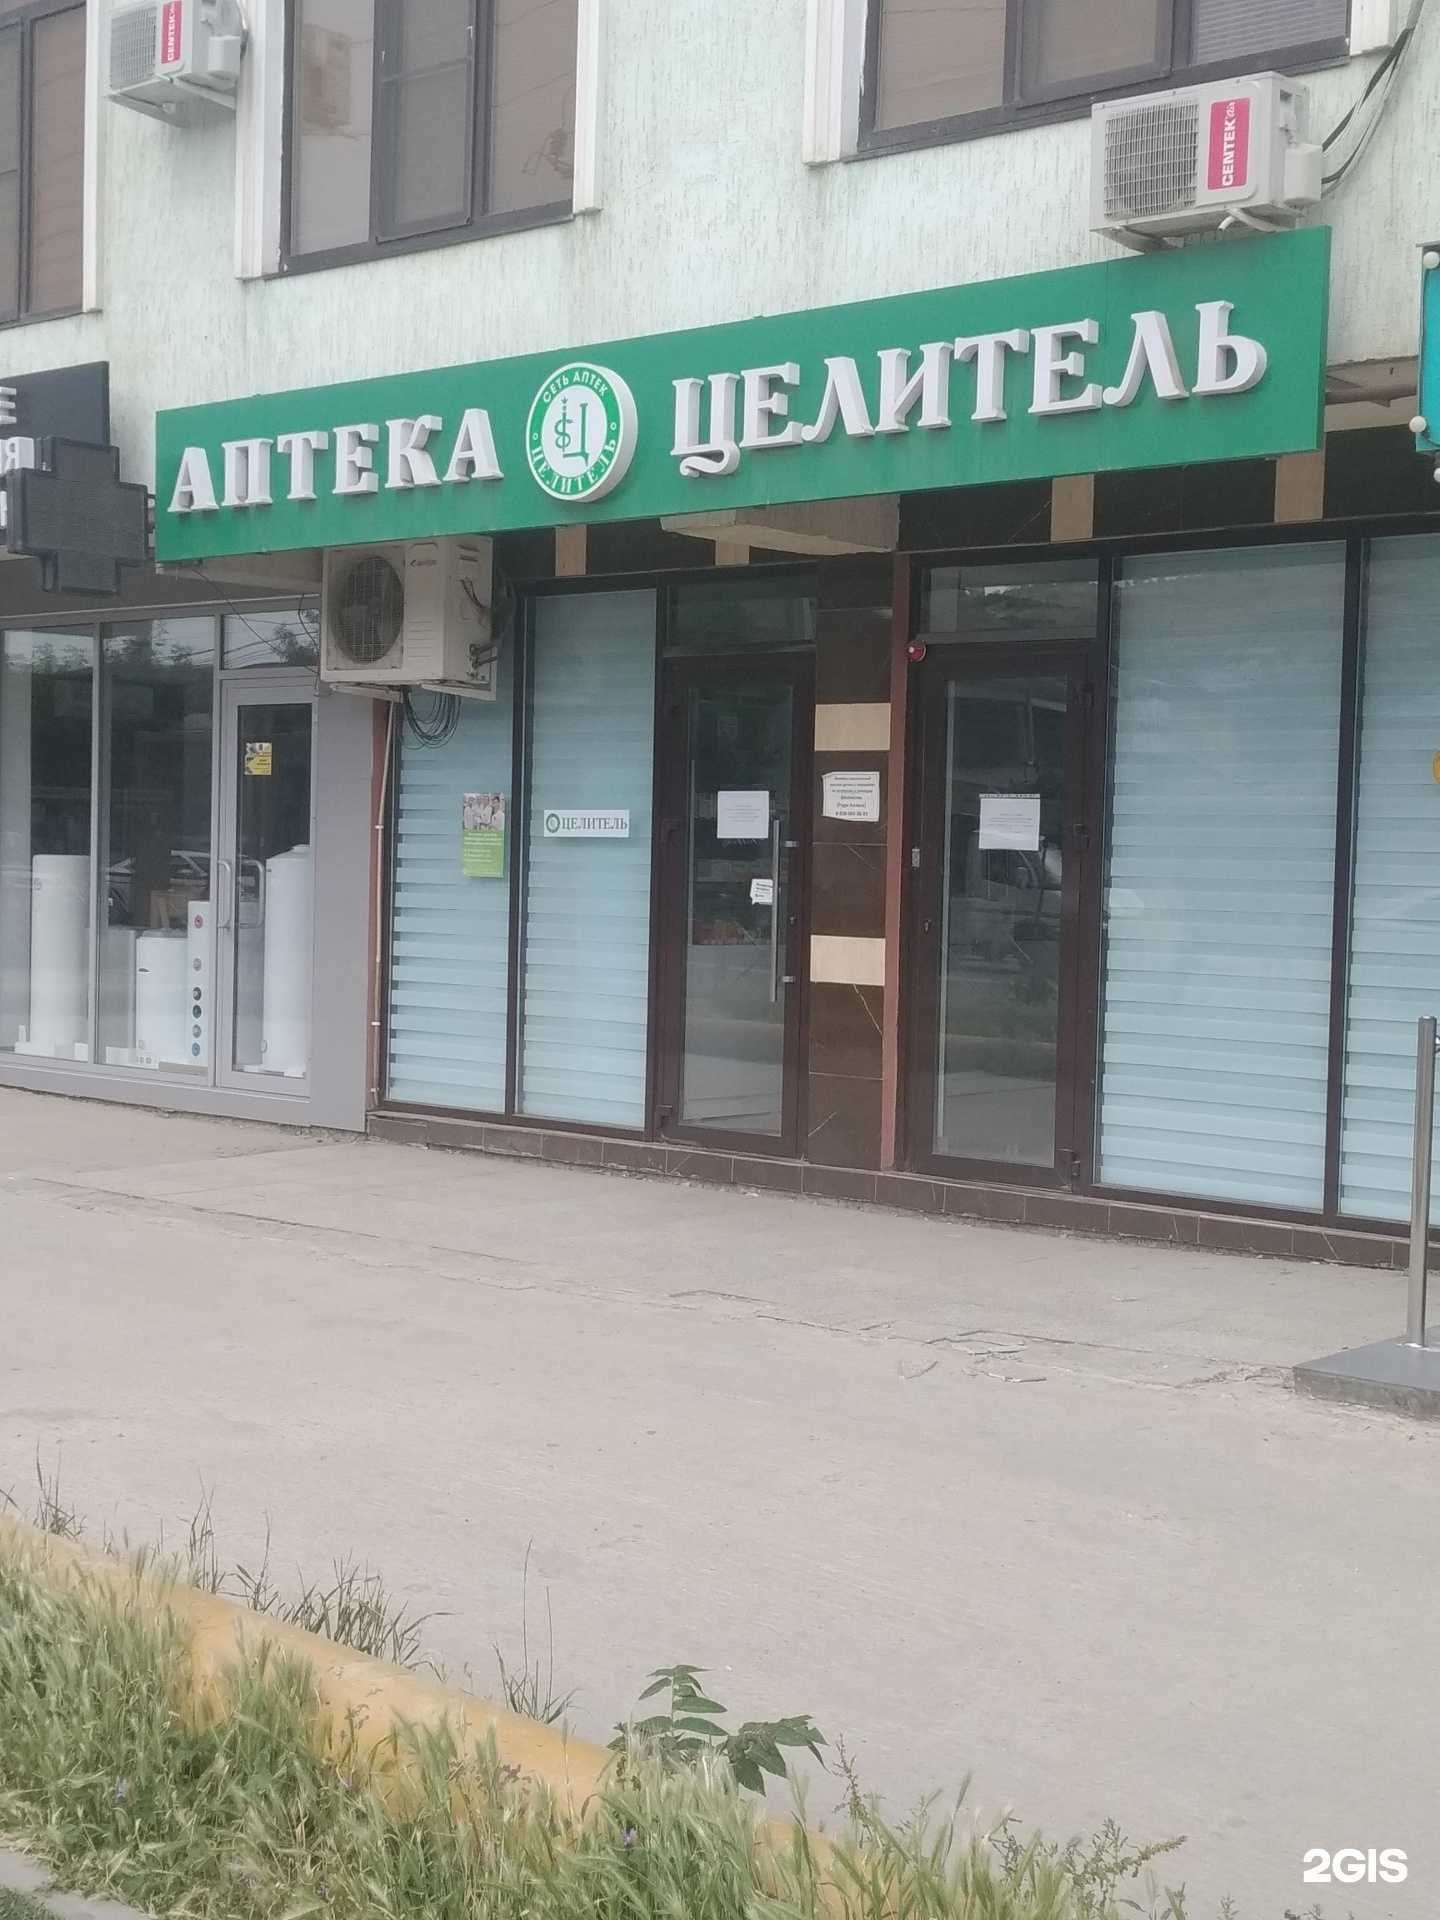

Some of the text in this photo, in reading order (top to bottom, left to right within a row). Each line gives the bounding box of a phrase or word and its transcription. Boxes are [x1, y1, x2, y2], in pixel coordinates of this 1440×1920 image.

[1222, 118, 1237, 187] CENTEK
[543, 371, 608, 403] СЕТЬ АПТЕК
[670, 301, 1268, 478] ЦЕЛИТЕЛЬ
[168, 408, 504, 512] АПТЕКА
[532, 439, 617, 494] ЦЕЛИТЕЛЬ
[562, 817, 628, 830] ЦЕЛИТЕЛЬ
